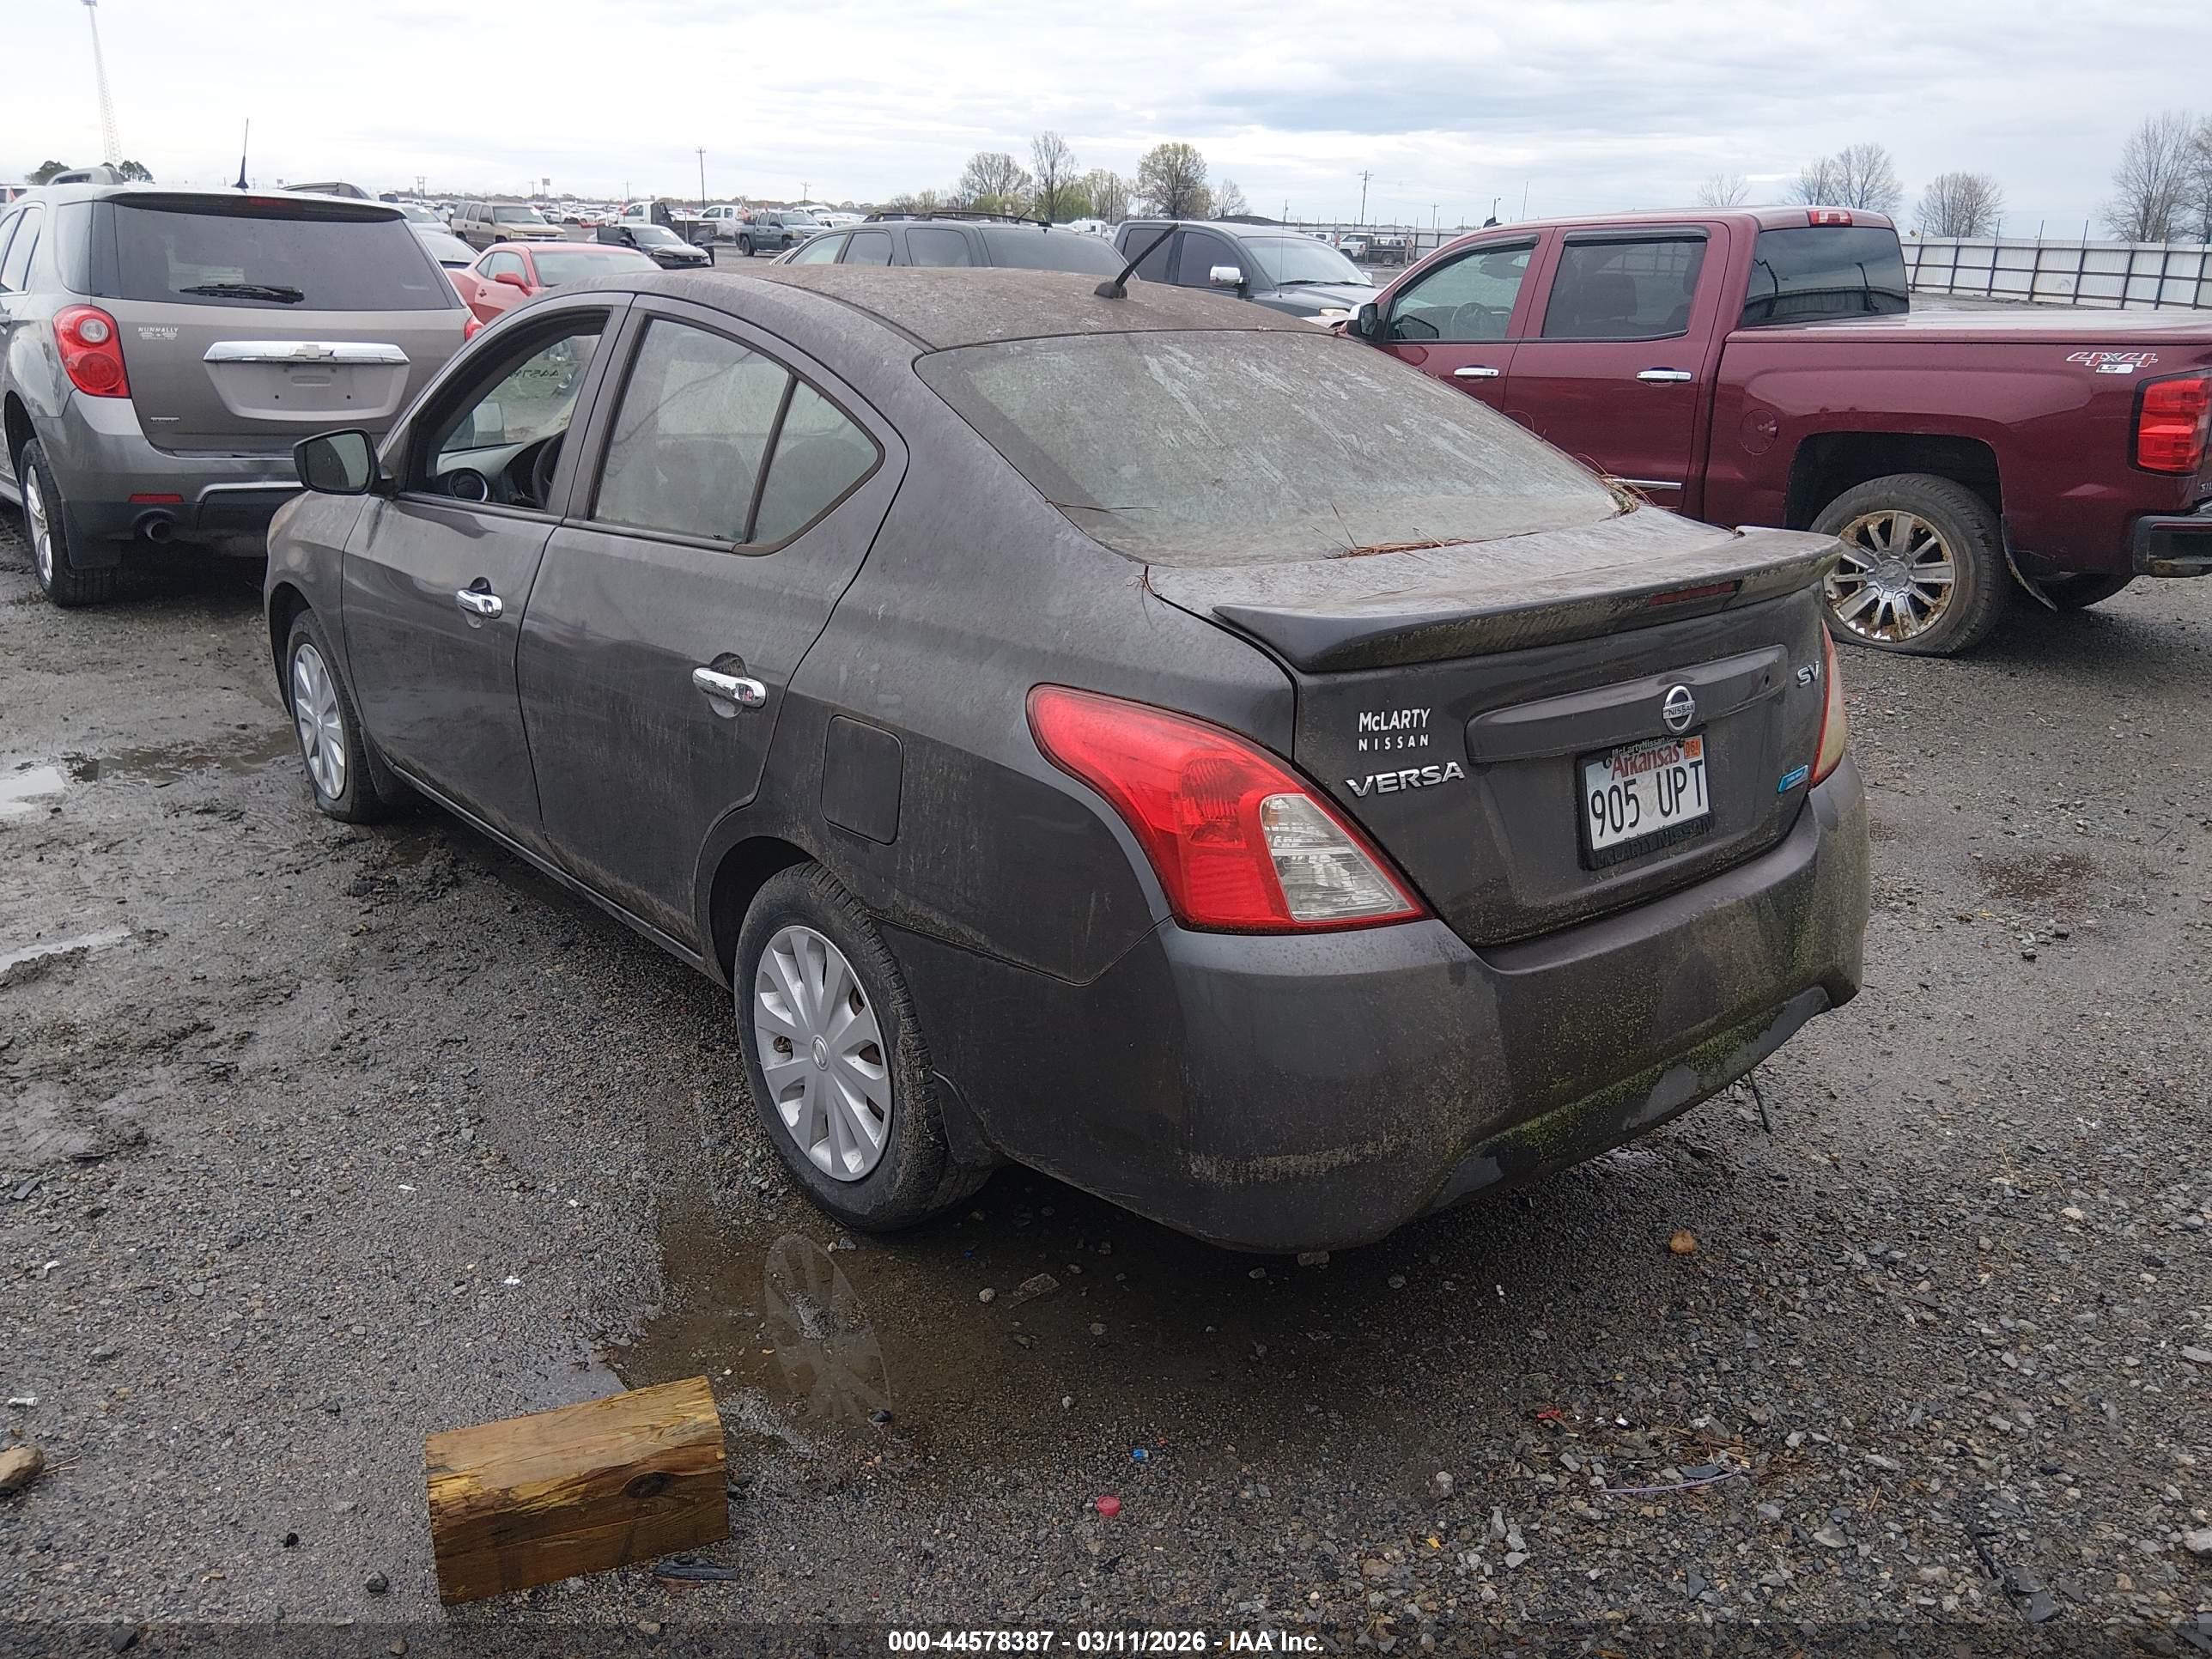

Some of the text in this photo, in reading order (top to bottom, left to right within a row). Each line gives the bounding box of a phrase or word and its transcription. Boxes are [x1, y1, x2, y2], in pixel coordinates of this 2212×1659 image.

[1797, 660, 1820, 685] SV
[1668, 704, 1694, 716] NISSAN
[1358, 734, 1429, 751] NISSAN
[1611, 743, 1680, 781] Arkansas
[1346, 761, 1465, 797] VERSA
[1590, 759, 1704, 839] 905 UPT
